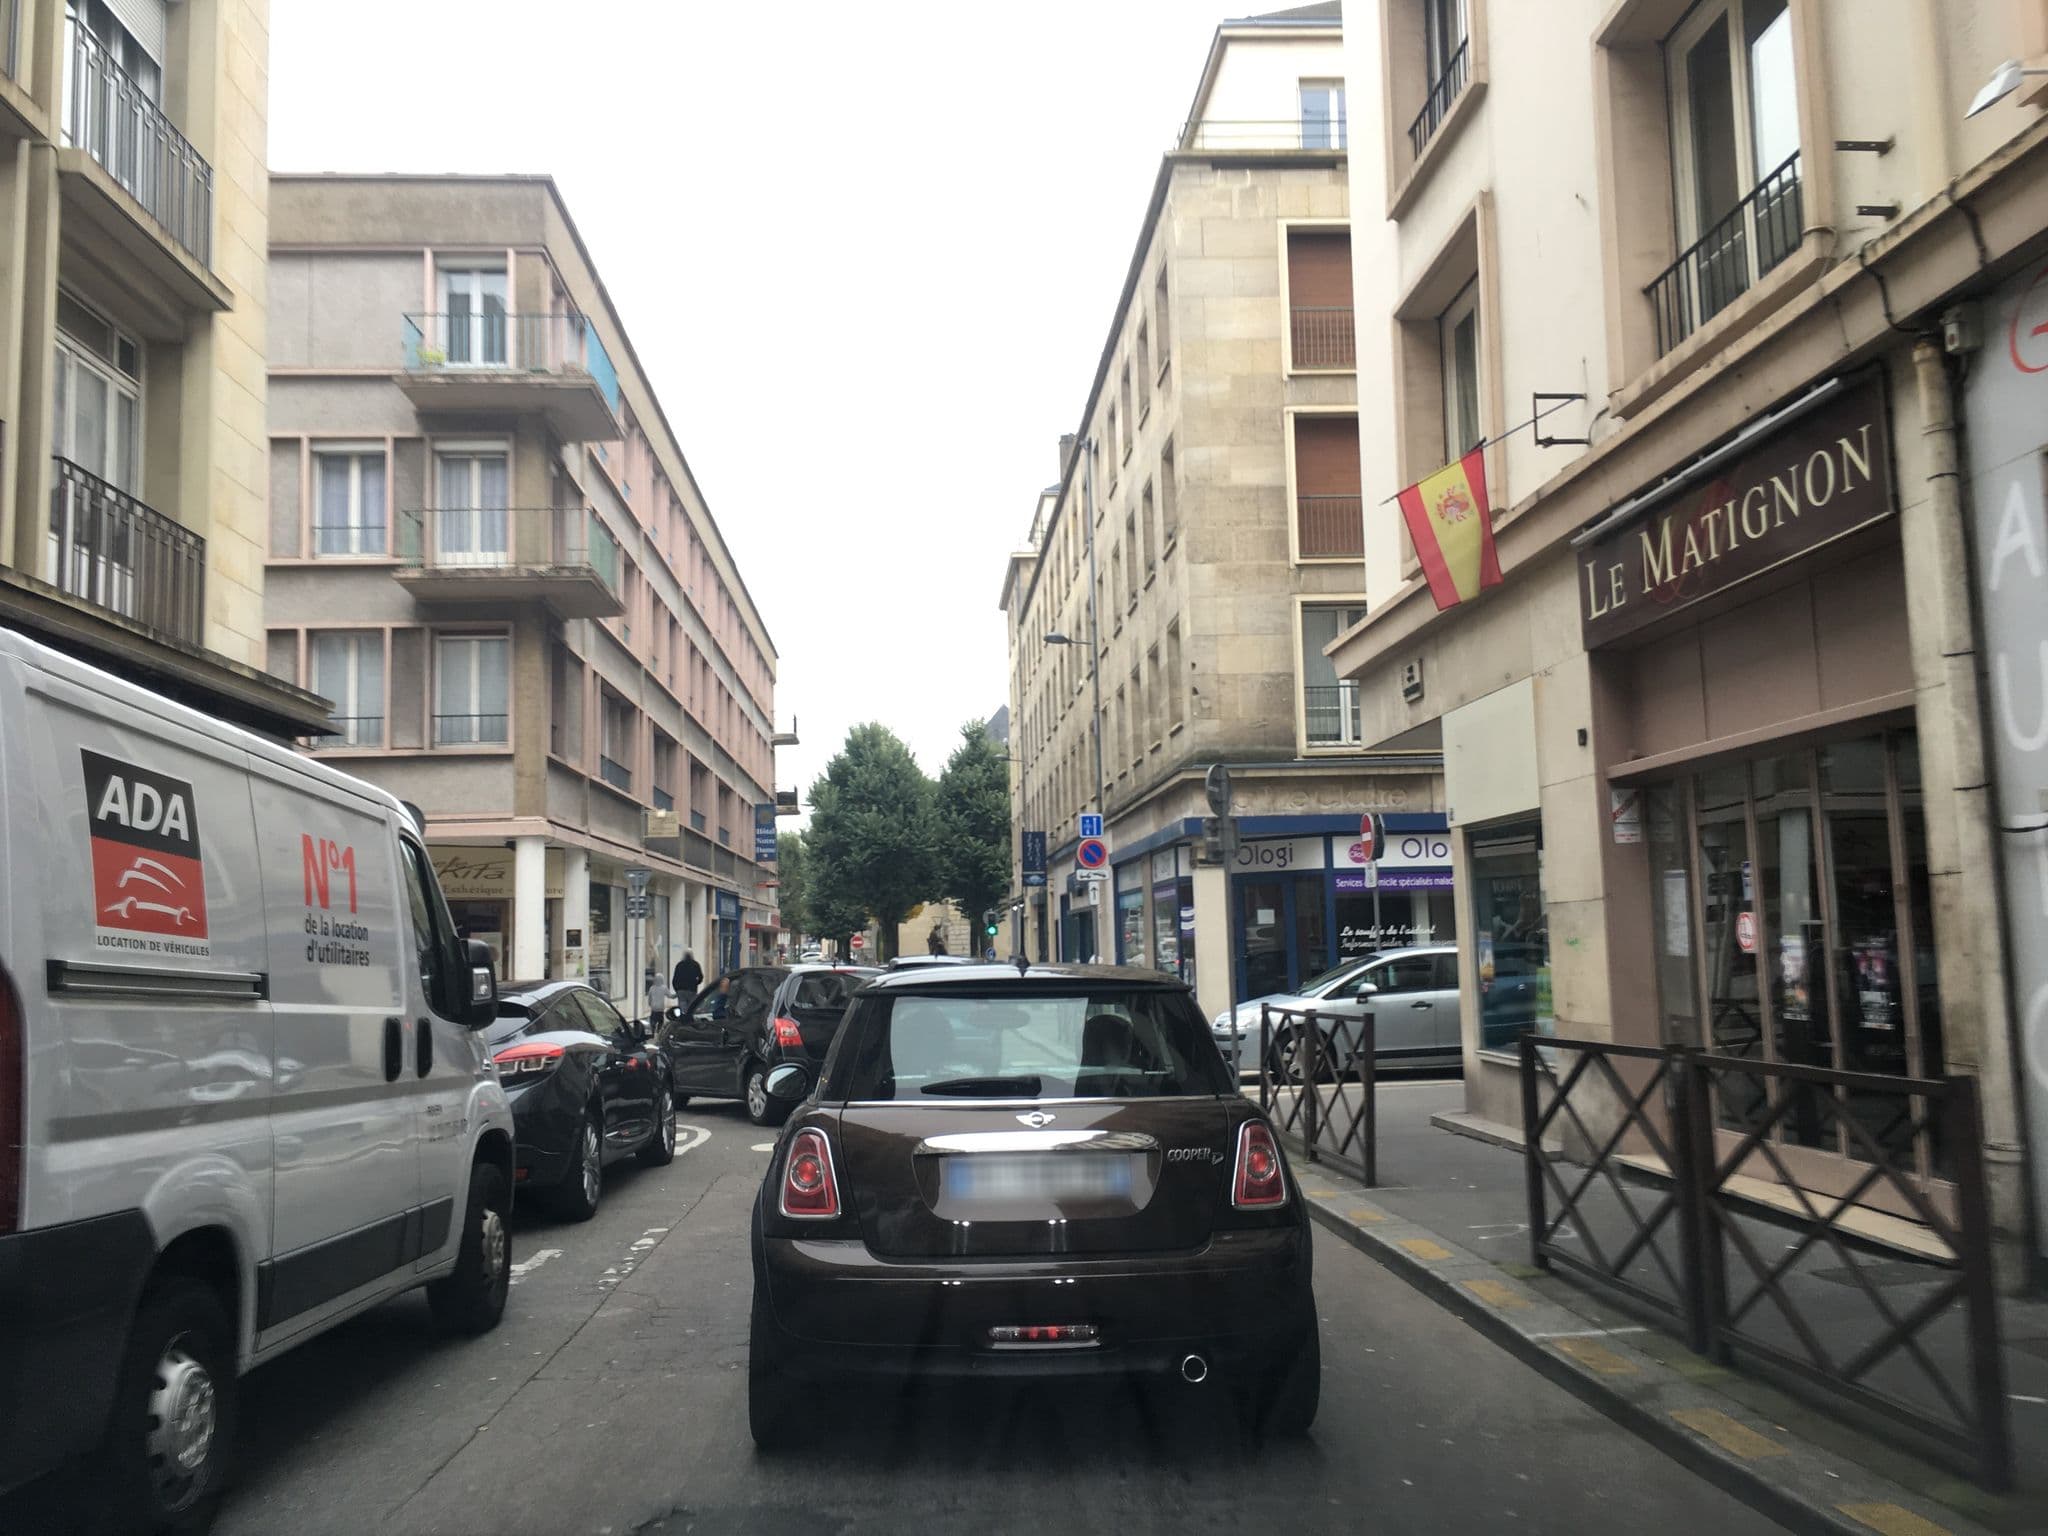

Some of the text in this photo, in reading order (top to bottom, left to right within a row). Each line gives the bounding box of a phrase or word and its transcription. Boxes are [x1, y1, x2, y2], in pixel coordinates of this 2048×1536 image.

[1638, 423, 1872, 594] MATIGNON
[97, 775, 190, 841] ADA
[305, 913, 369, 941] de la location
[1355, 925, 1385, 939] souffe
[97, 935, 210, 957] LOCATION DE VÉHICULES
[306, 939, 370, 966] d'utilitaires
